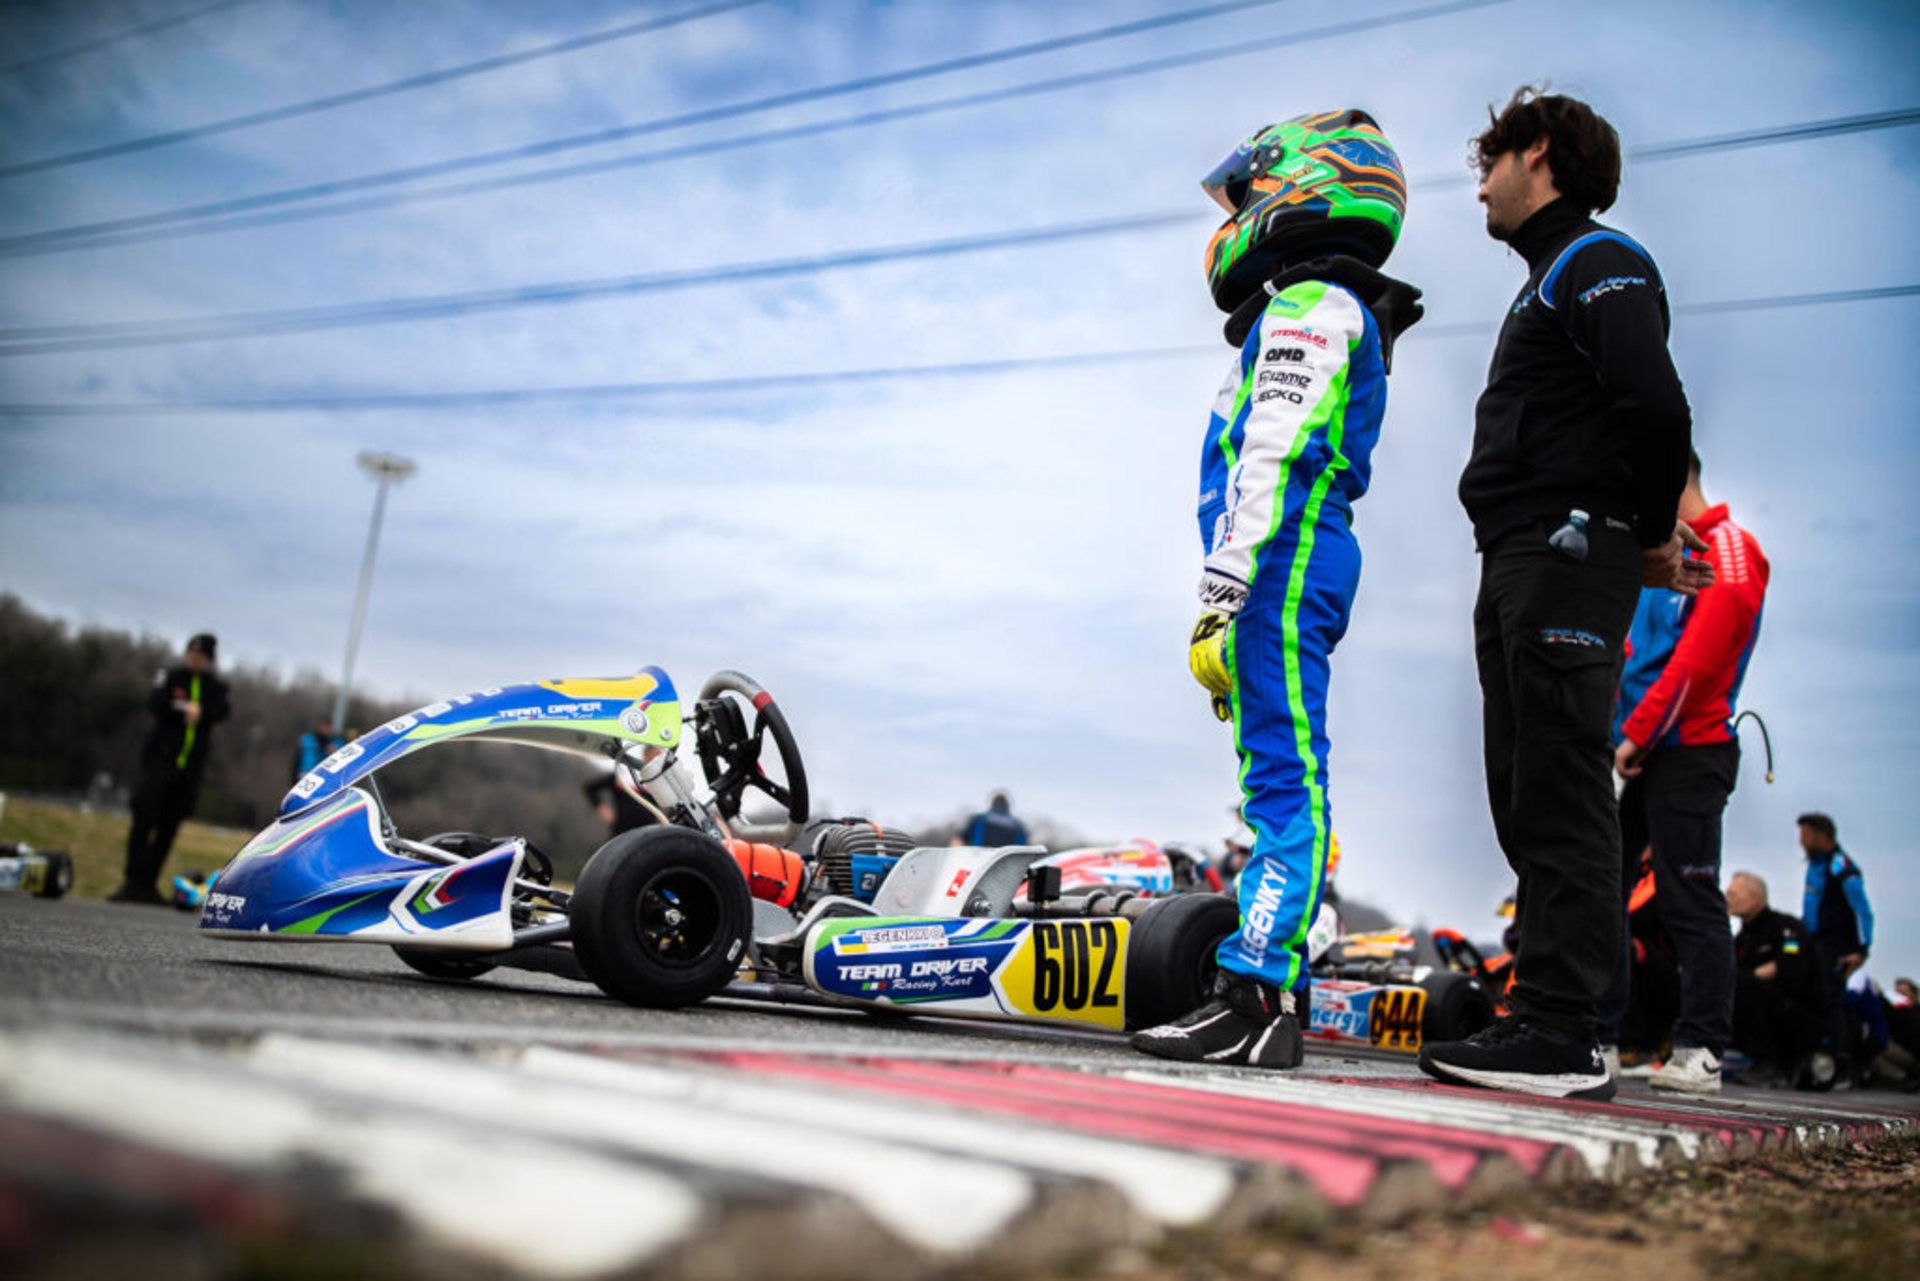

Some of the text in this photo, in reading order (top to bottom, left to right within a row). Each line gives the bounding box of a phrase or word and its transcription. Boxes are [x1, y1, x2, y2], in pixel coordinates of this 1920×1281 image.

[498, 706, 542, 718] TEAM
[837, 957, 988, 981] TEAM DRIVER
[1032, 920, 1119, 1012] 602
[892, 978, 938, 991] Racing
[1310, 1008, 1368, 1035] nergy
[1369, 988, 1420, 1046] 644
